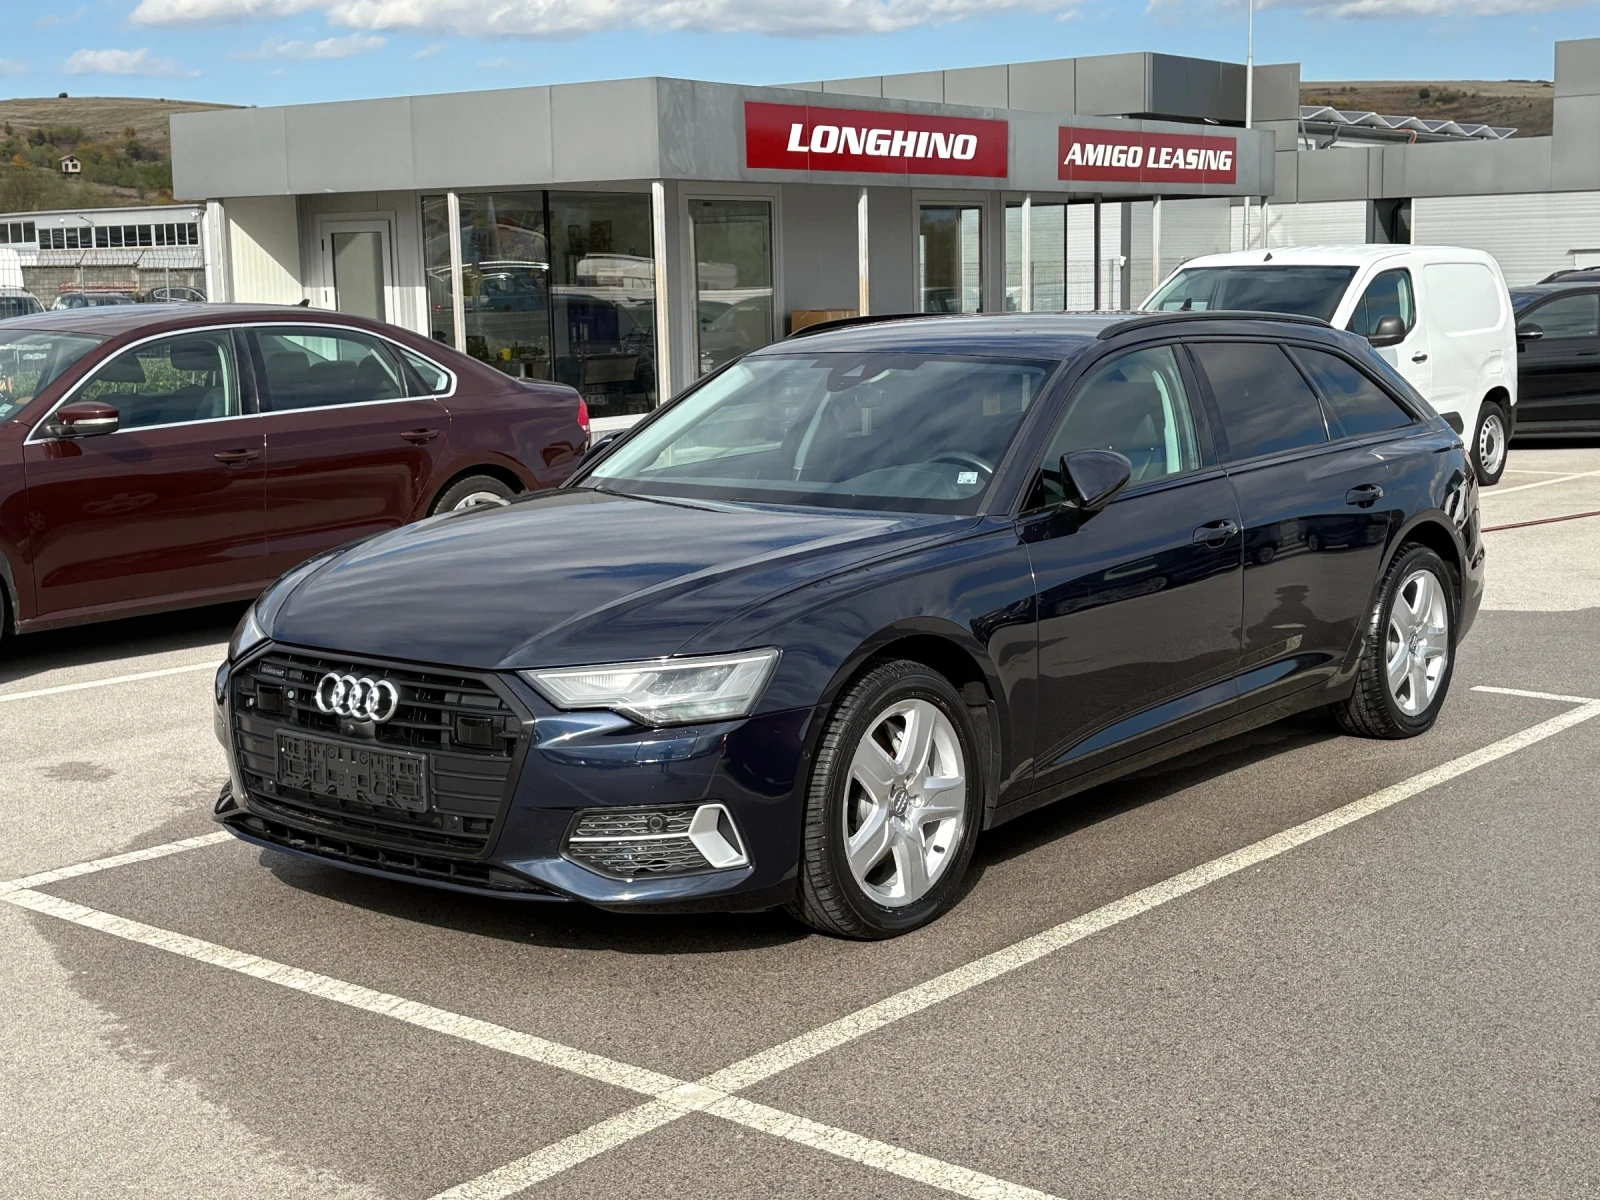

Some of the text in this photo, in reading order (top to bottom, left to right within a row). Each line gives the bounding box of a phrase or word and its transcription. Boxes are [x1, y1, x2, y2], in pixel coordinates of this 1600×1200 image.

[786, 123, 978, 160] LONGHINO
[1063, 142, 1233, 171] AMIGO LEASING
